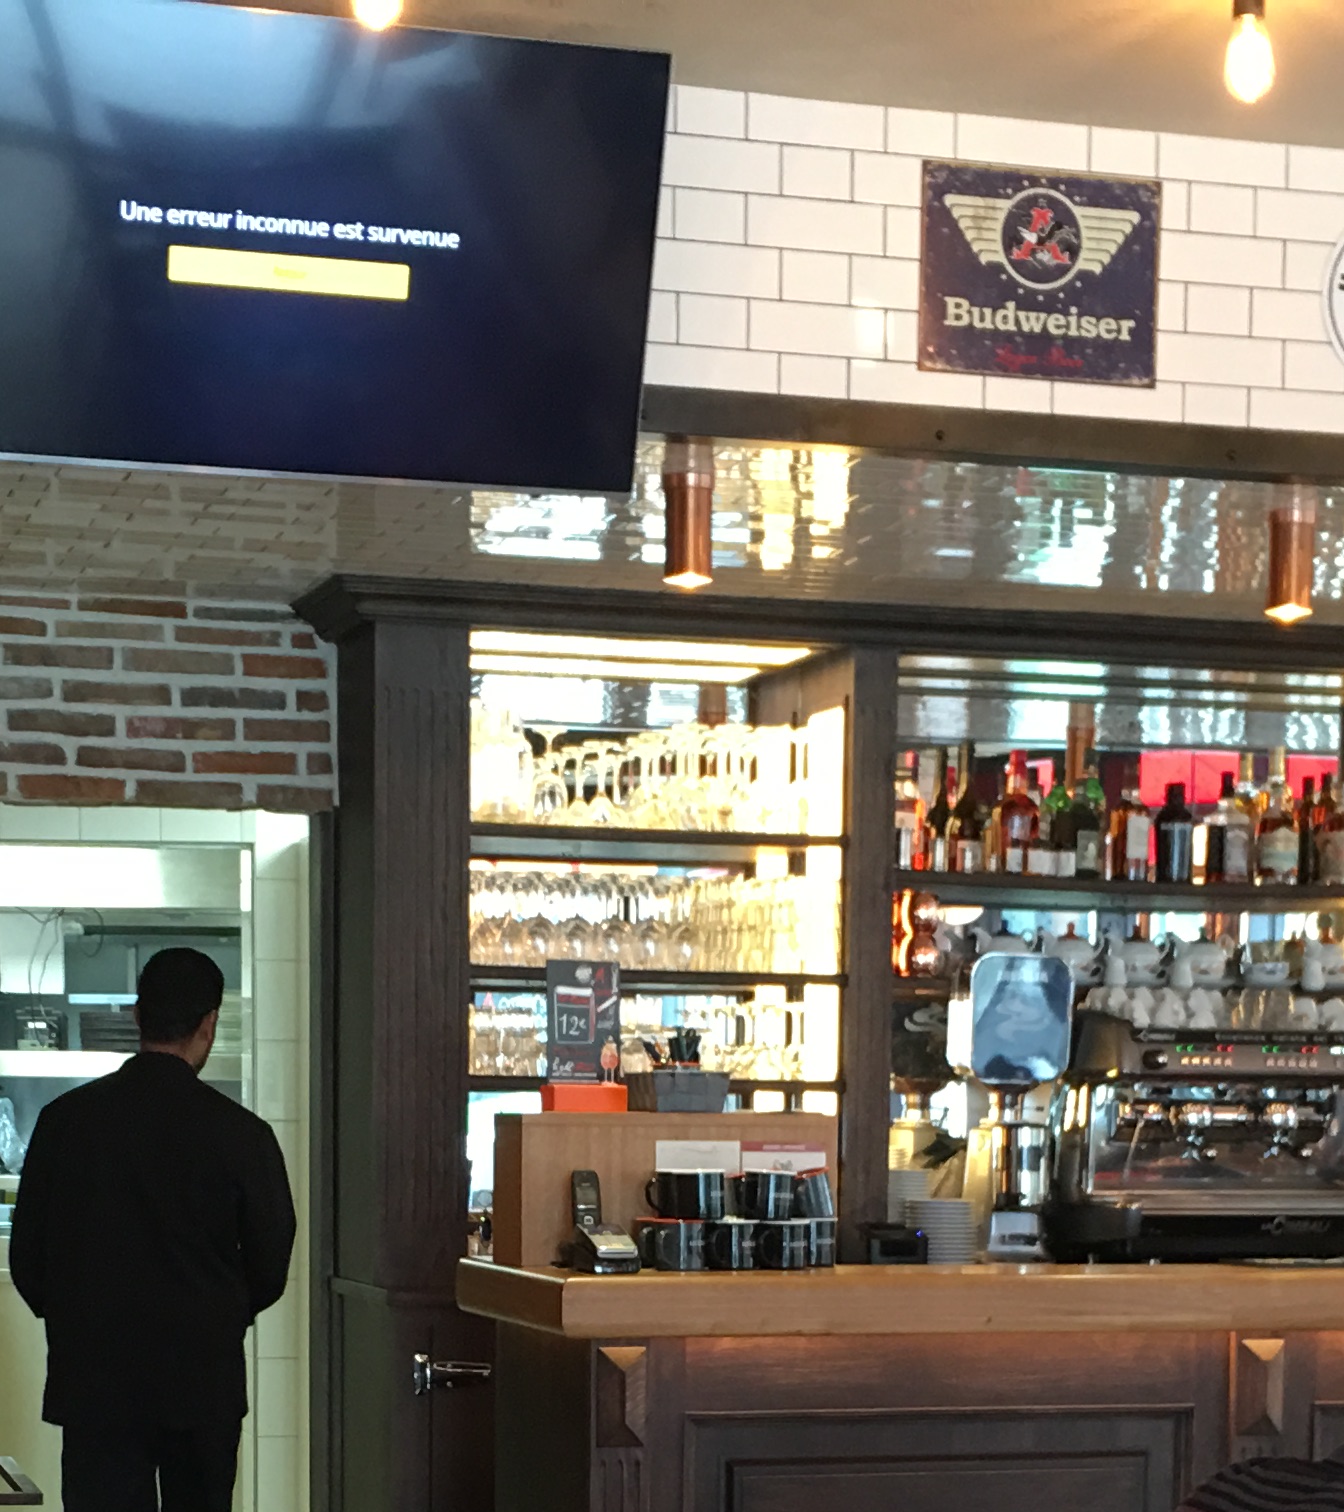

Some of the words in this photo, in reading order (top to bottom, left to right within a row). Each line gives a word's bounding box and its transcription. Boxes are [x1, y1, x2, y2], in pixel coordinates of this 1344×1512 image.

[119, 199, 164, 224] Une
[166, 206, 233, 230] erreur
[235, 209, 331, 239] inconnue
[333, 221, 365, 242] est
[366, 225, 461, 250] survenue
[943, 296, 1137, 342] Budweiser
